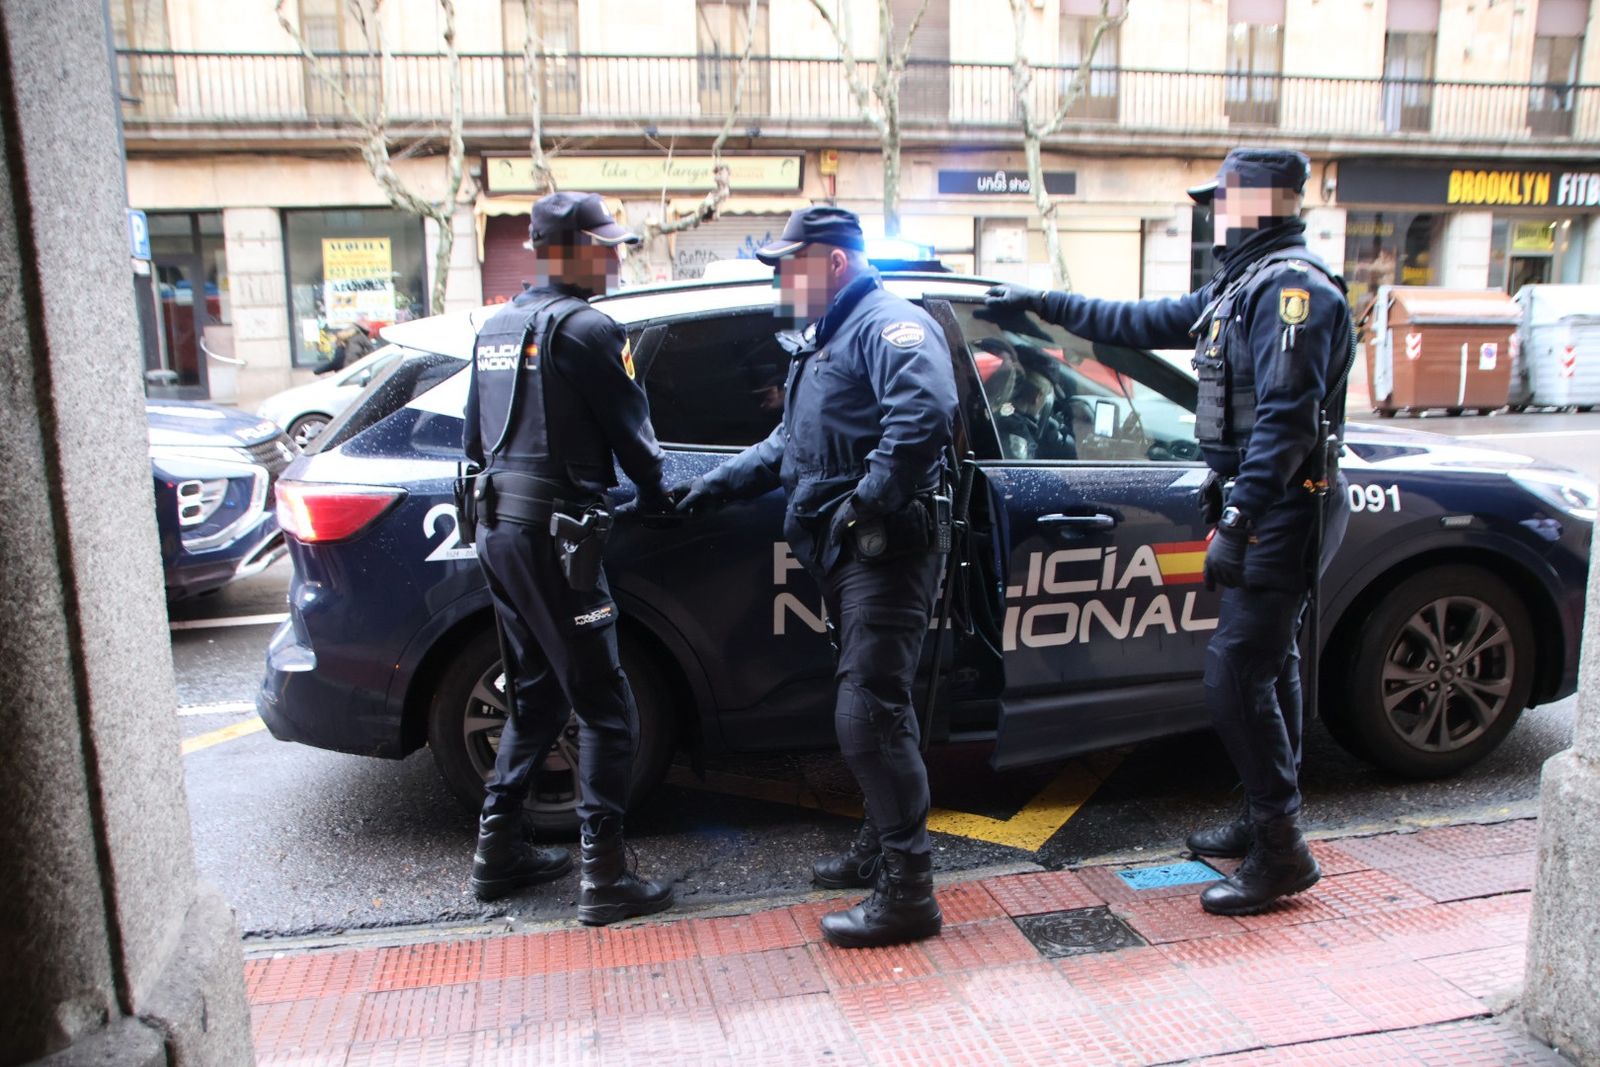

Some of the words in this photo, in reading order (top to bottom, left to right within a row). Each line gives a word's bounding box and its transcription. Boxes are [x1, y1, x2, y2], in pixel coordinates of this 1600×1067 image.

[1009, 177, 1031, 192] sho
[1448, 170, 1550, 205] BROOKLYN
[1557, 172, 1600, 206] FITB
[131, 214, 147, 254] P
[477, 357, 537, 371] NACIONL
[1350, 484, 1401, 513] 091
